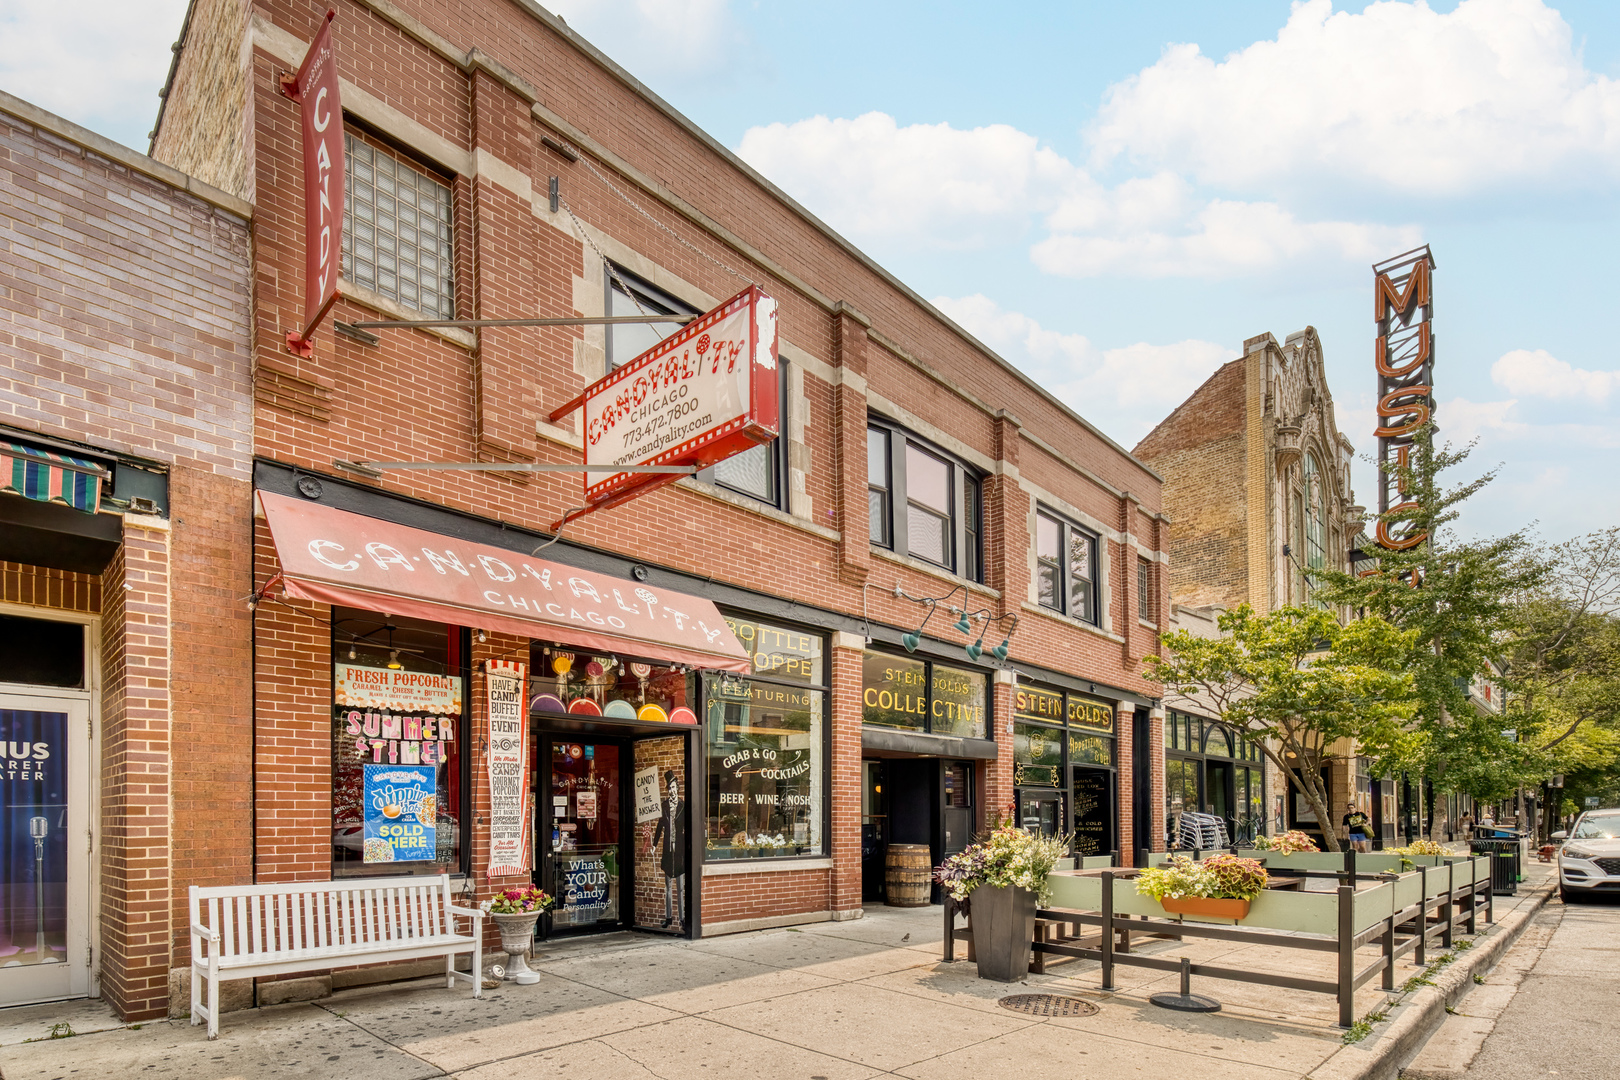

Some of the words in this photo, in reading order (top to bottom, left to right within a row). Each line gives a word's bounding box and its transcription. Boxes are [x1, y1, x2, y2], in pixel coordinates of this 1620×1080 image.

[313, 86, 331, 305] CANDY
[630, 384, 688, 424] CHICAGO
[1373, 258, 1432, 550] MUSIC
[622, 397, 699, 449] 773.472.7800
[613, 412, 713, 466] www.candyality.com
[482, 589, 627, 630] CHICAGO
[725, 620, 811, 653] BOTTLE
[746, 650, 812, 677] OPPE
[345, 667, 389, 686] FRESH
[393, 672, 454, 692] POPCORN!
[492, 679, 511, 692] HAVE
[351, 682, 384, 692] CARAMEL
[391, 686, 415, 695] CHEESE
[423, 689, 449, 698] BUTTER
[724, 685, 810, 706] FEATURING
[491, 702, 519, 716] BUFFET
[863, 687, 984, 724] COLLECTIVE
[346, 711, 454, 740] SUMMER
[491, 720, 520, 733] EVENT!
[369, 738, 448, 765] TIME!
[722, 749, 751, 769] GRAB
[752, 748, 761, 759] &
[762, 748, 777, 761] GO
[492, 768, 520, 776] CANDY
[760, 759, 811, 780] COCKTAILS
[492, 776, 520, 787] GOURMET
[636, 773, 656, 788] CANDY
[492, 785, 520, 796] POPCORN
[642, 795, 653, 804] THE
[719, 793, 746, 804] BEER
[755, 793, 780, 806] WINE
[787, 794, 812, 807] NOSH
[638, 802, 661, 817] ANSWER
[379, 825, 424, 838] SOLD
[388, 836, 427, 849] HERE
[568, 859, 605, 871] What's
[565, 872, 607, 887] YOUR
[567, 886, 605, 901] Candy
[562, 899, 612, 912] Personality?
